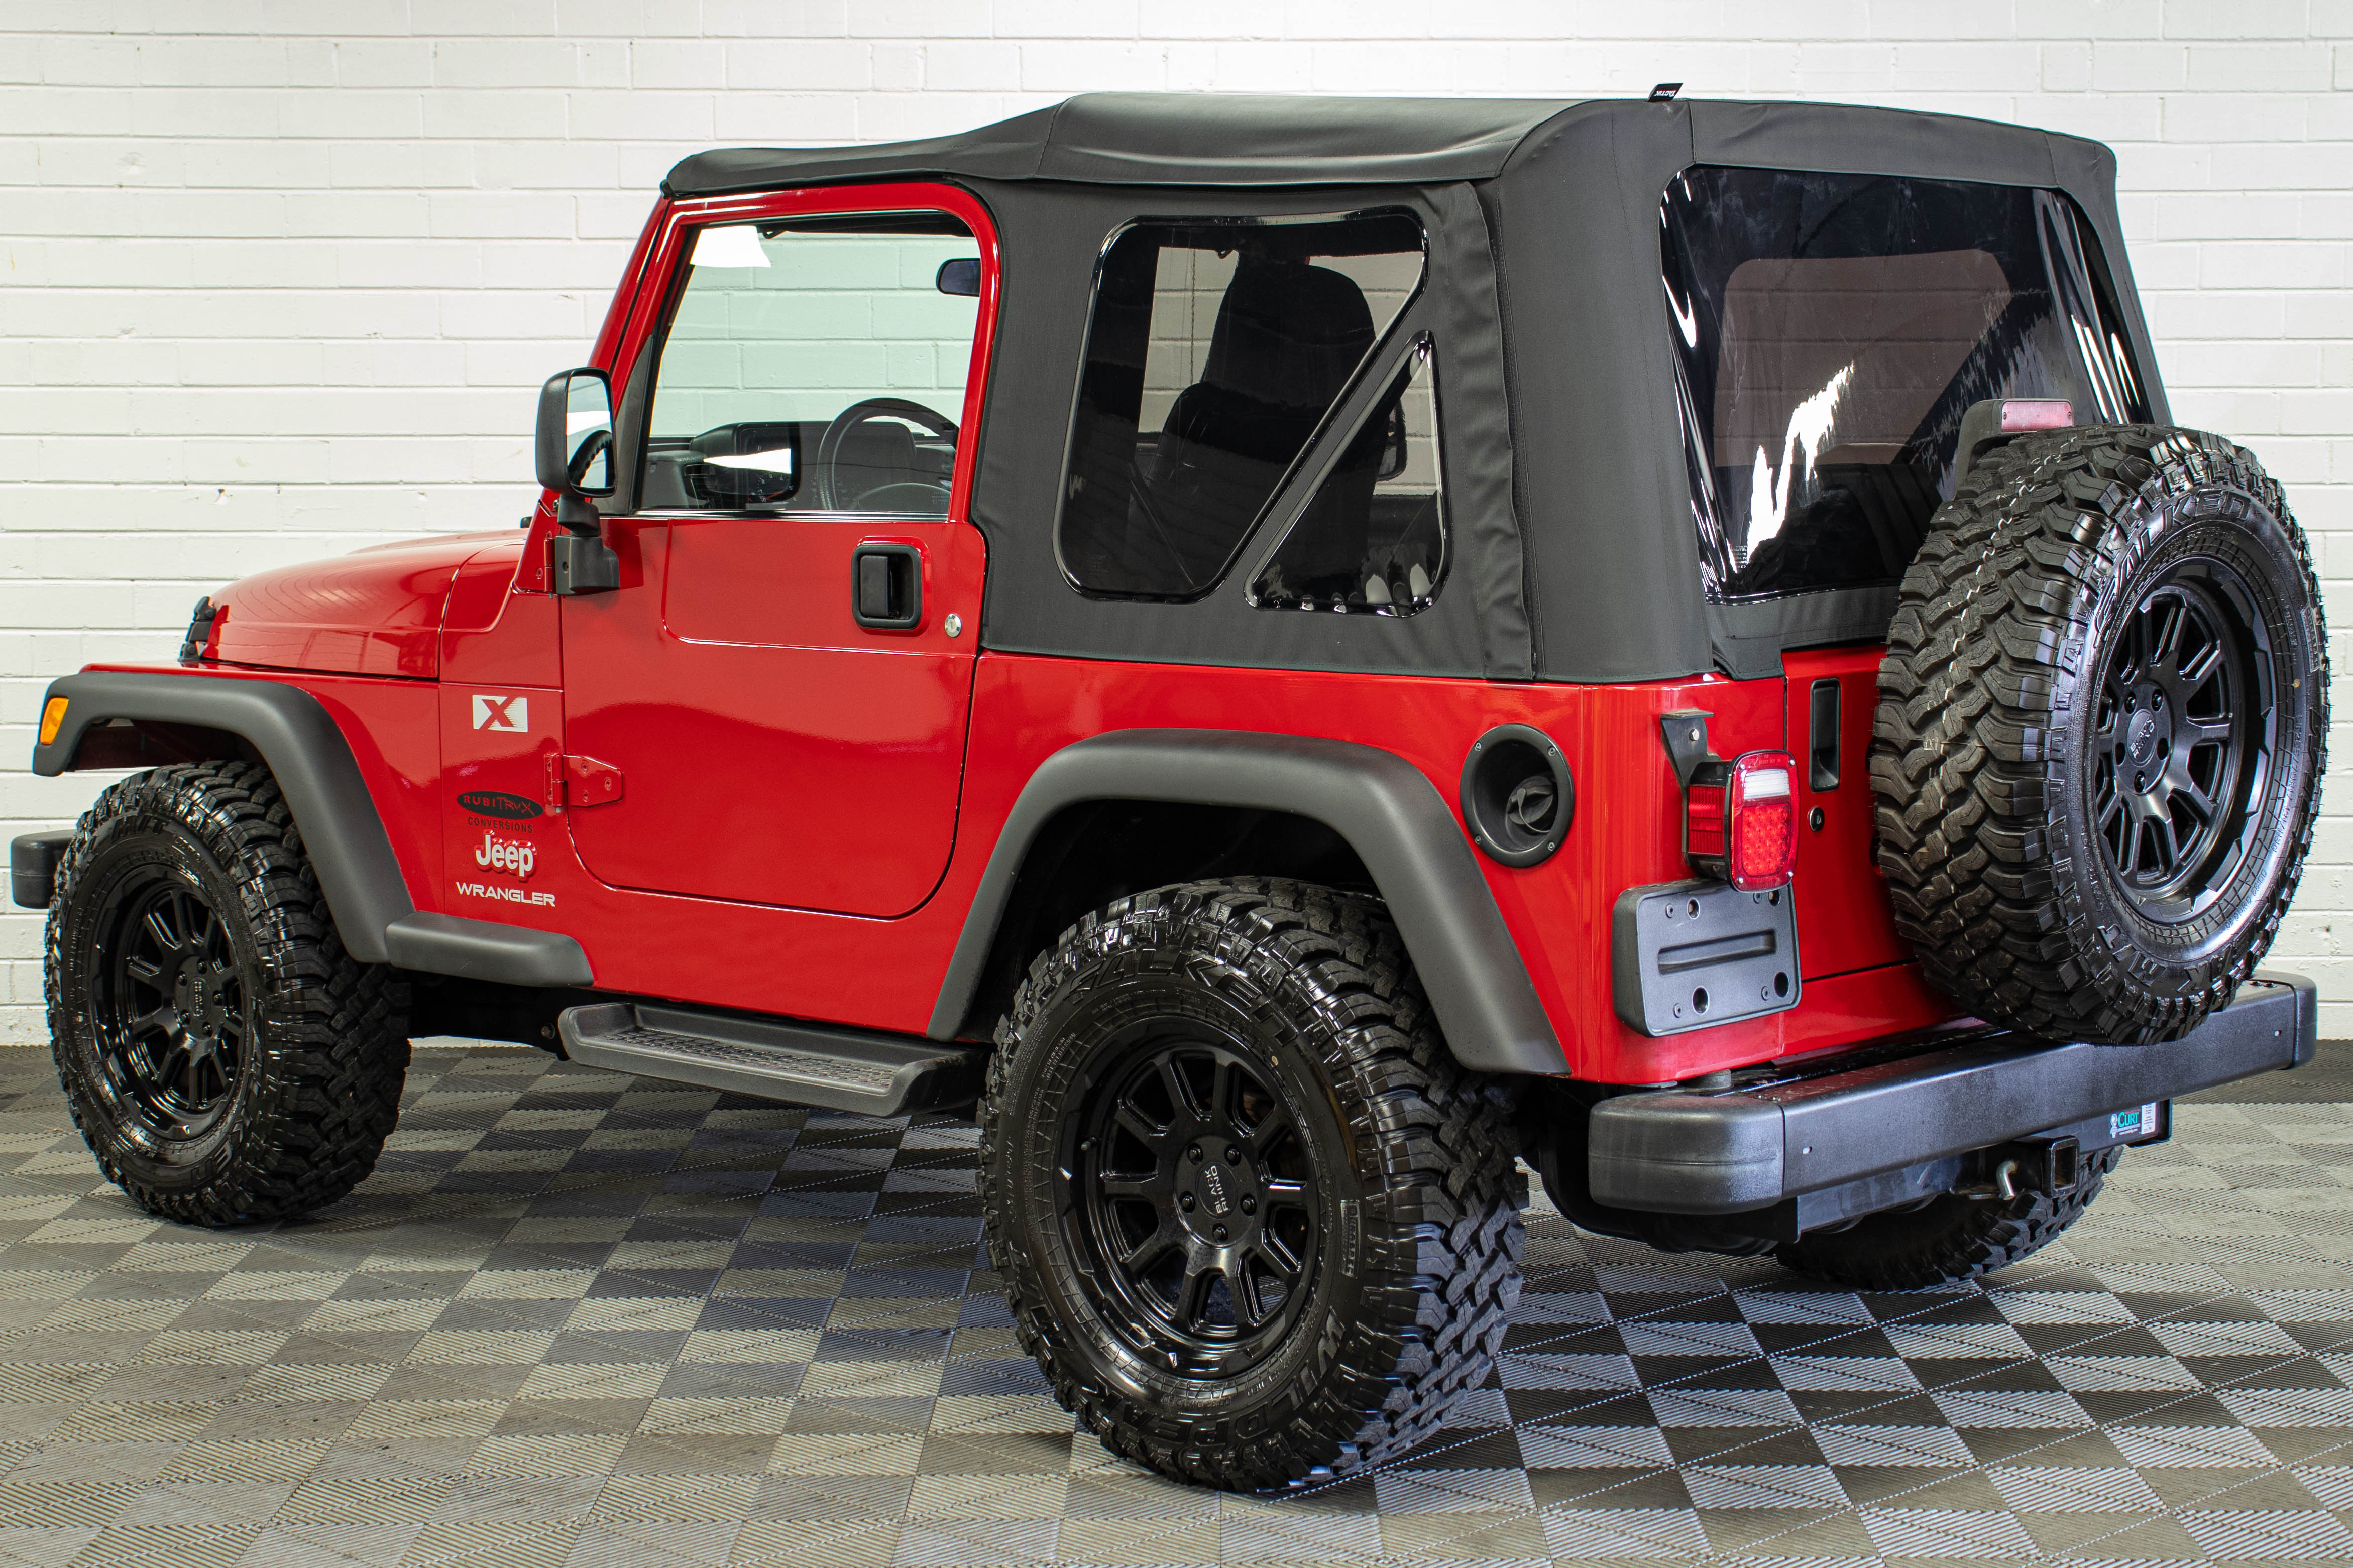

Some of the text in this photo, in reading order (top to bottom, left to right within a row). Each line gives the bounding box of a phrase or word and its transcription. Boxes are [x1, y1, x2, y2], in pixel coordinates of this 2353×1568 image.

[2094, 487, 2251, 648] FALKEN
[474, 695, 527, 732] X
[468, 817, 533, 833] CONVERSIONS
[475, 834, 534, 877] Jeep
[456, 882, 556, 907] WRANGLER
[1063, 948, 1299, 1047] FALKEN
[2118, 1111, 2140, 1128] CURT
[1205, 1168, 1222, 1214] BLACK
[1081, 1305, 1347, 1447] WILDPEAK
